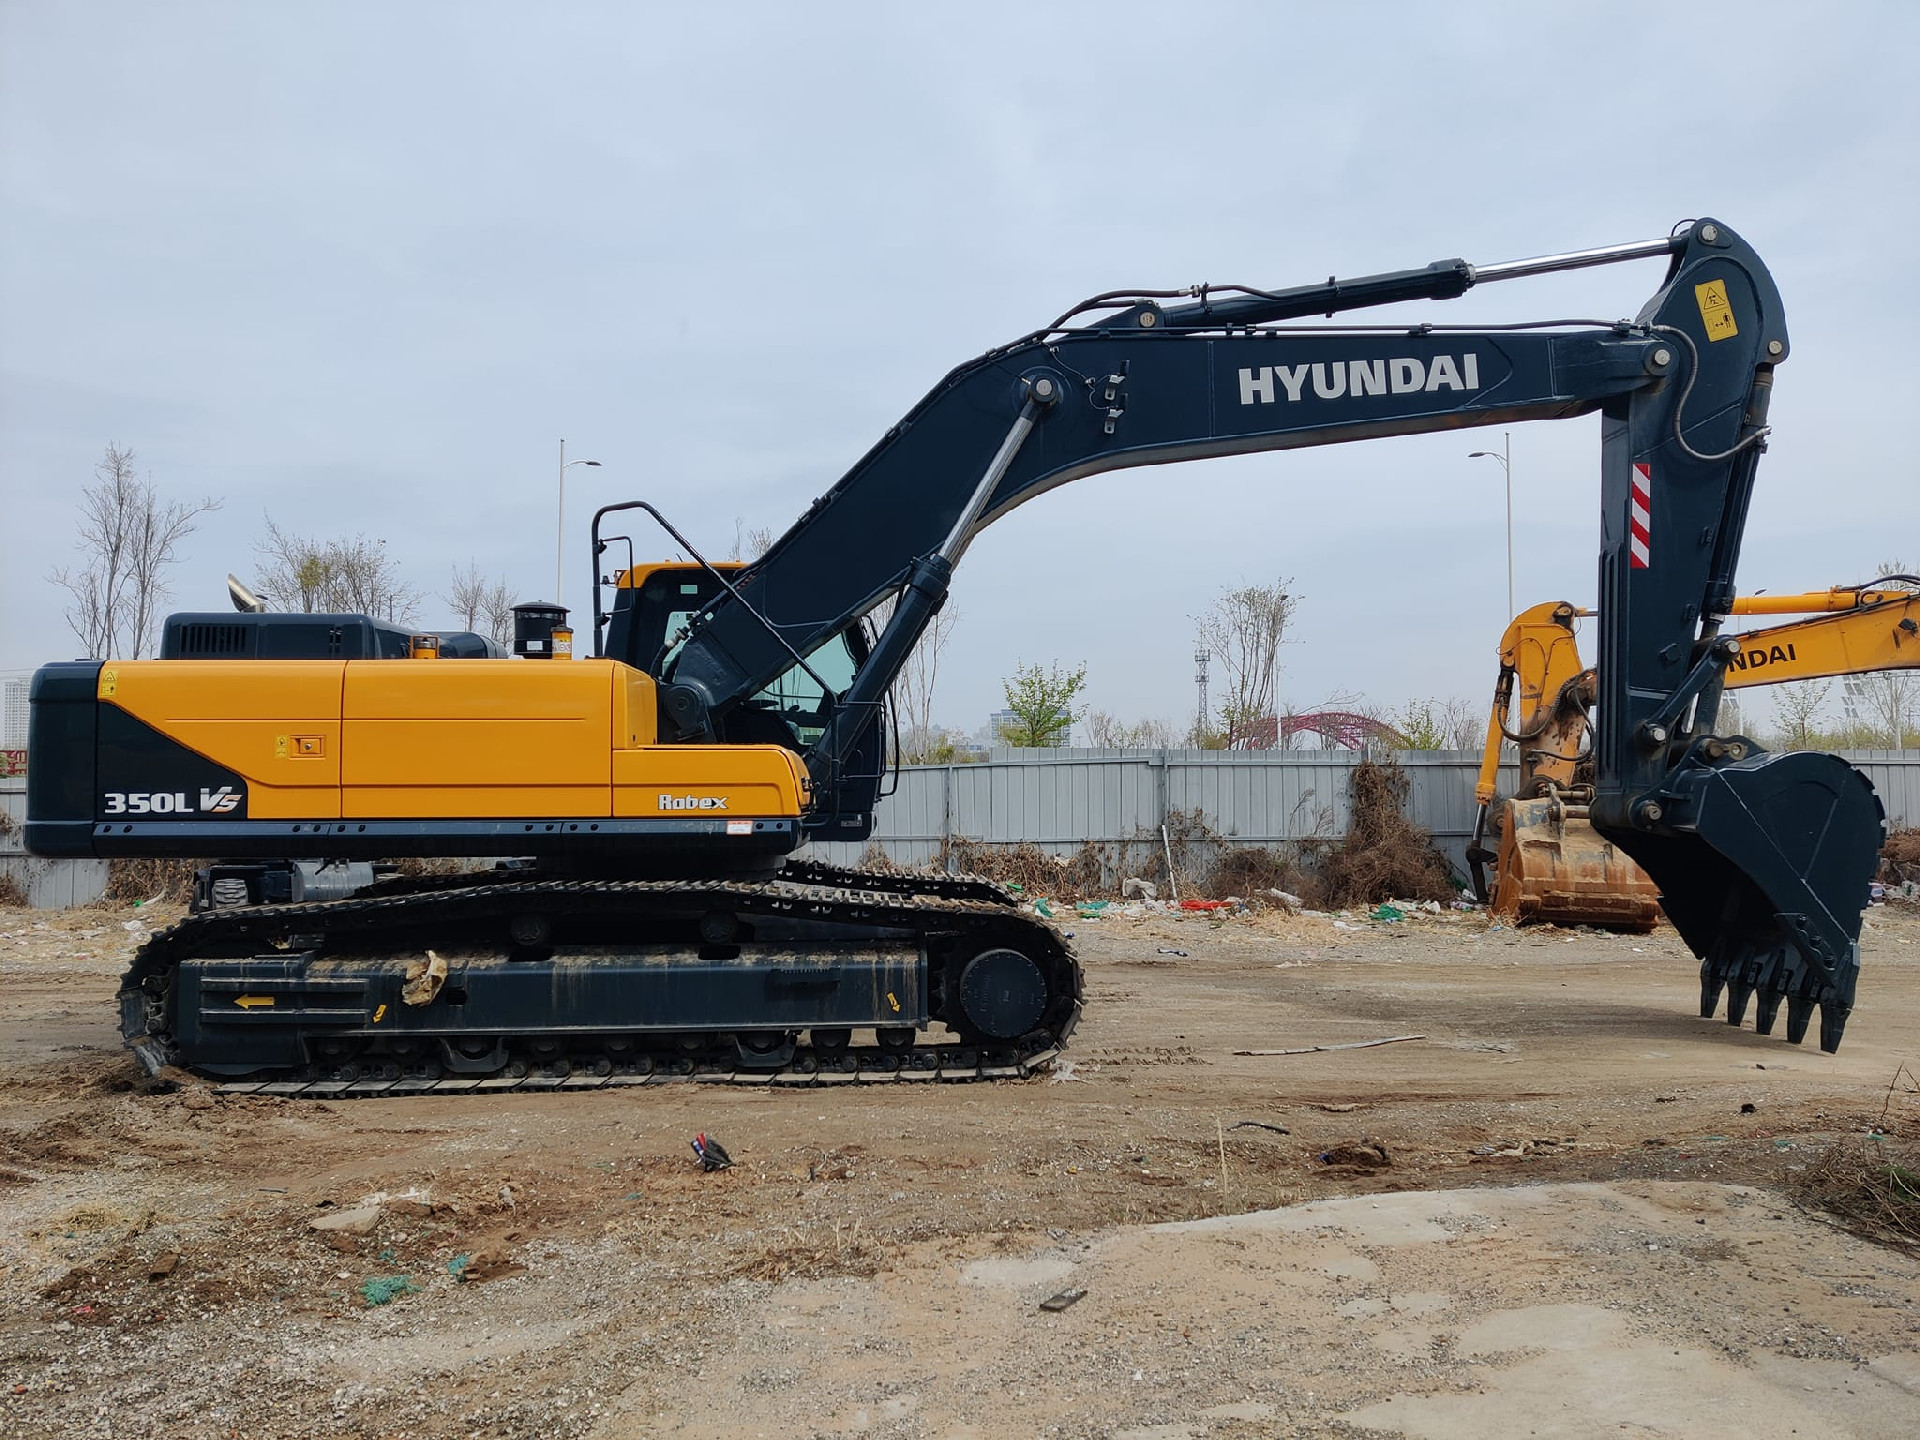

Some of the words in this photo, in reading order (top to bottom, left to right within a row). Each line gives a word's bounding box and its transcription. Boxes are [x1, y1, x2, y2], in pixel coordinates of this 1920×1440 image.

[1238, 353, 1480, 405] HYUNDAI
[104, 793, 194, 814] 350L
[658, 794, 728, 810] Robex
